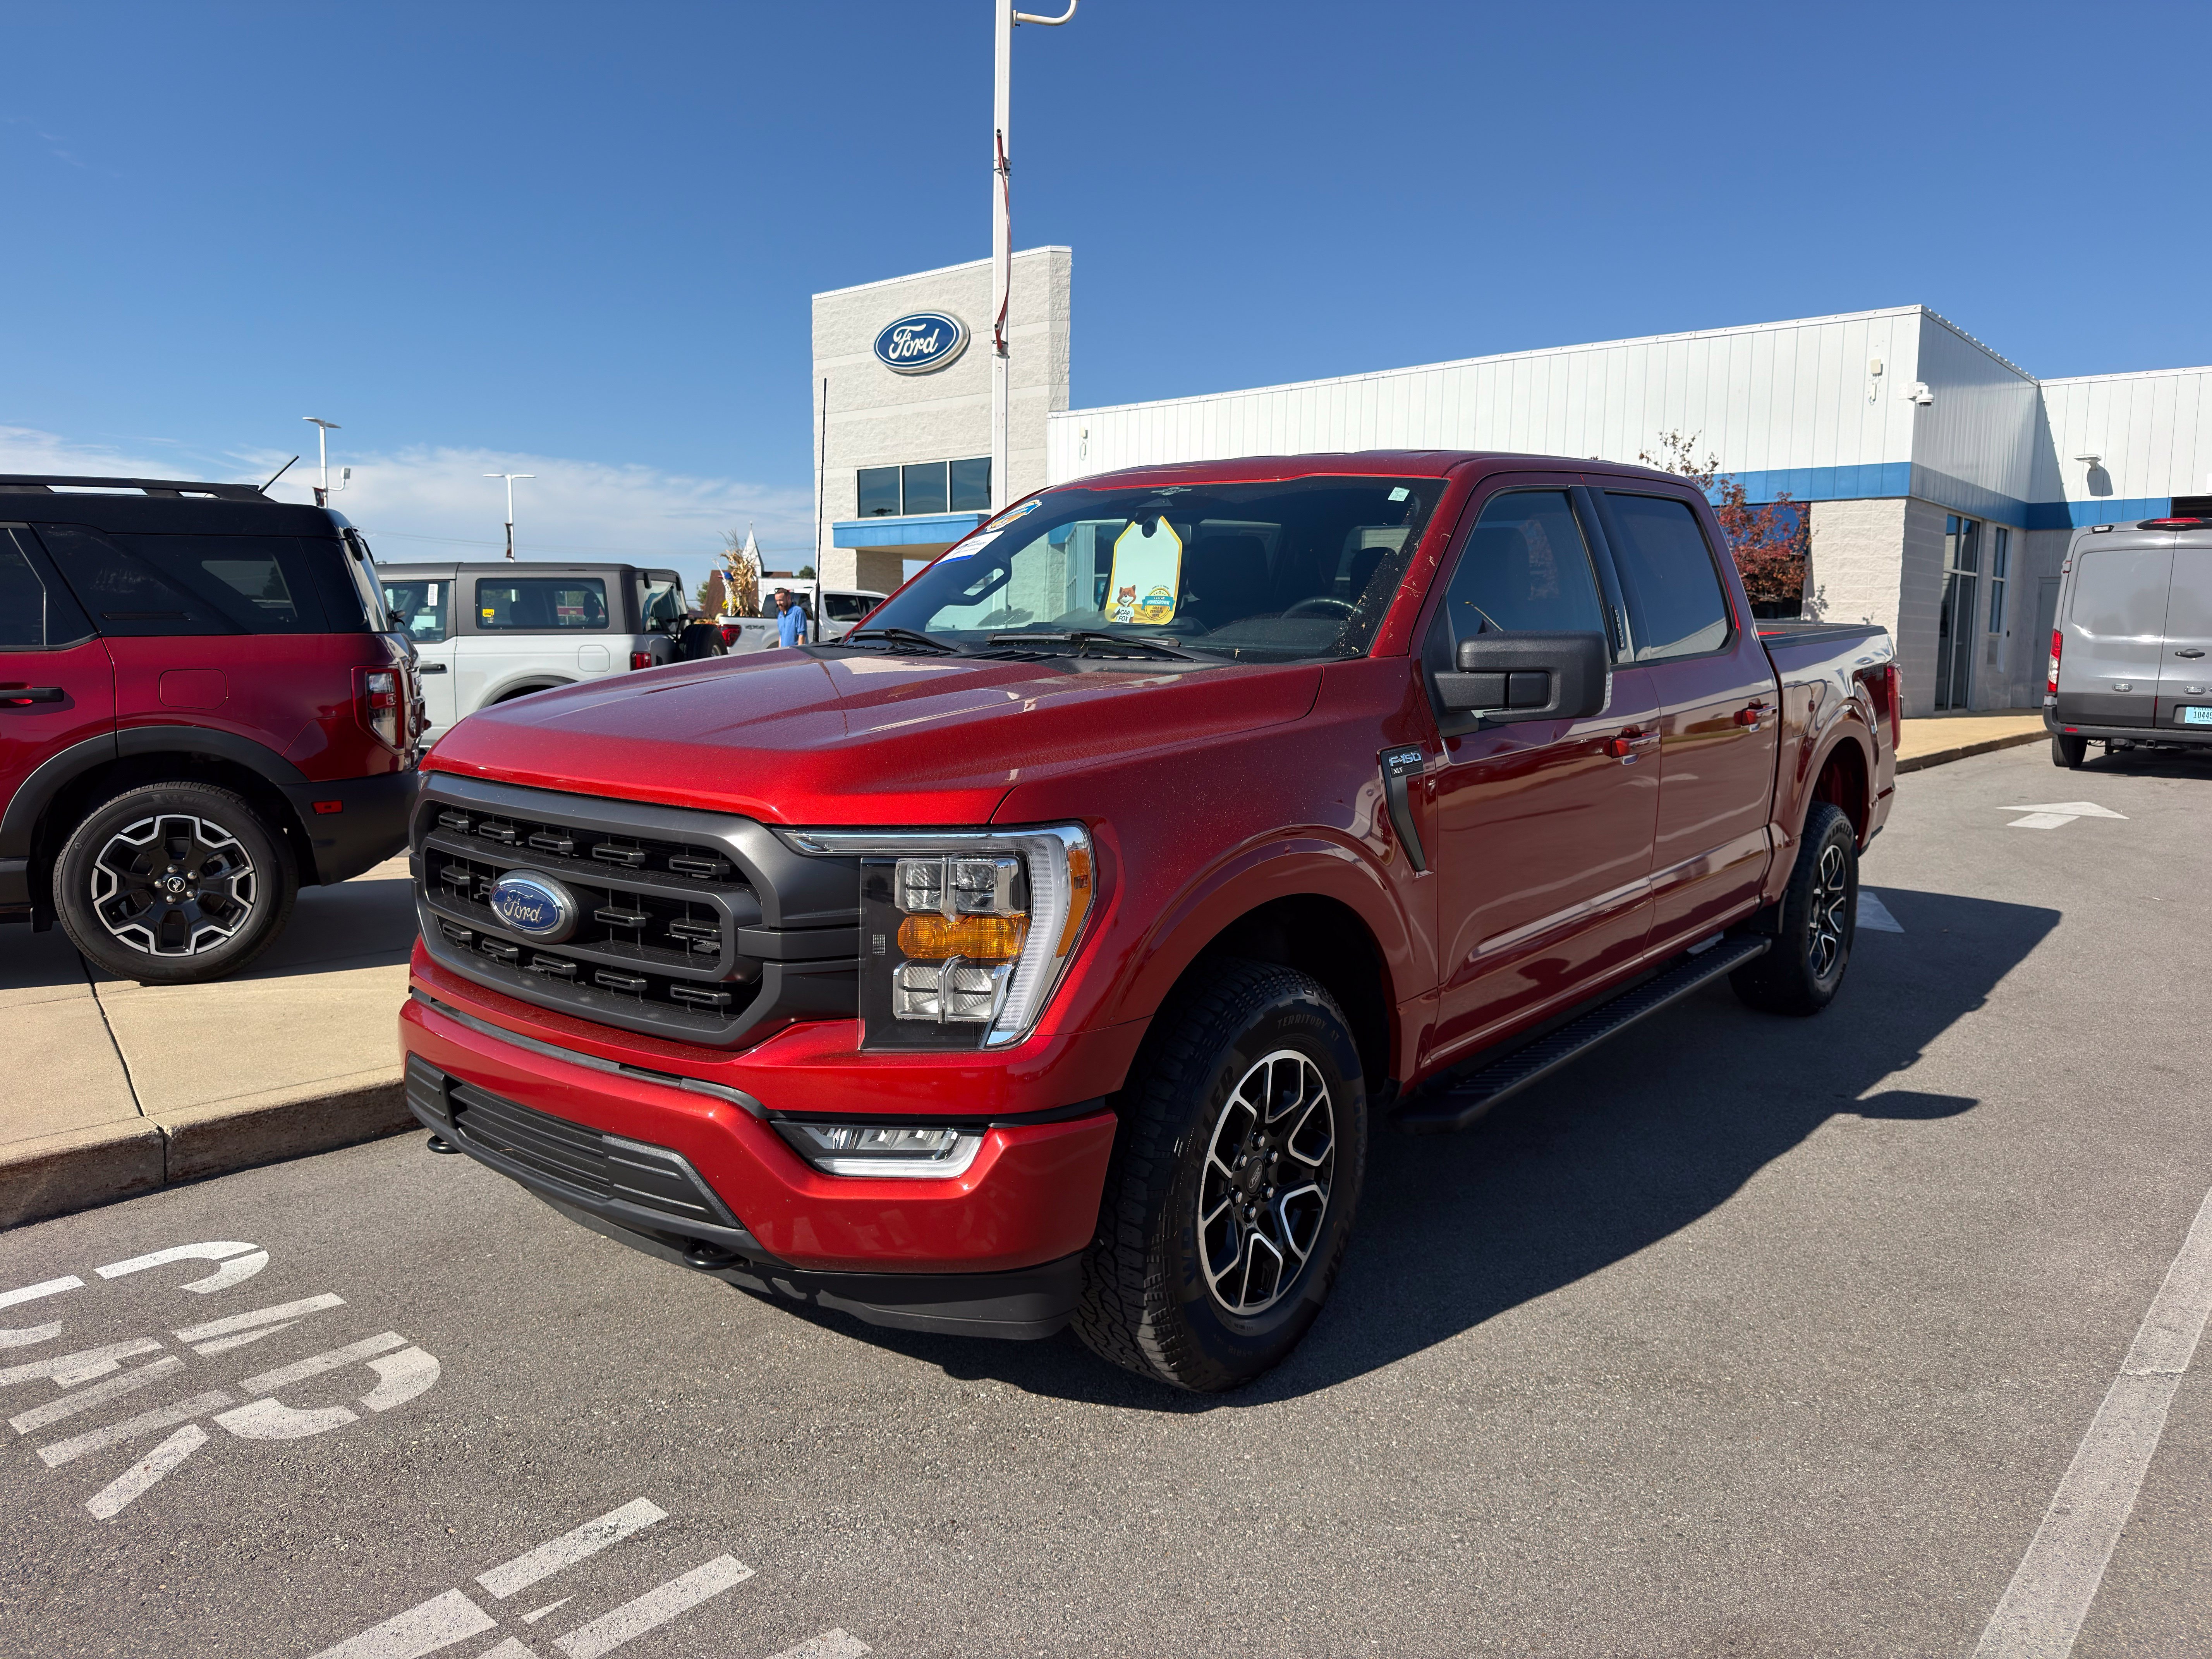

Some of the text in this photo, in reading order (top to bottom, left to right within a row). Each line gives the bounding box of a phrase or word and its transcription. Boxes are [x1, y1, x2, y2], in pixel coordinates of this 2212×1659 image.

[888, 323, 940, 360] Ford
[1388, 750, 1422, 767] F-150
[503, 889, 543, 924] Ford
[1277, 1013, 1341, 1042] TERRITORY AT
